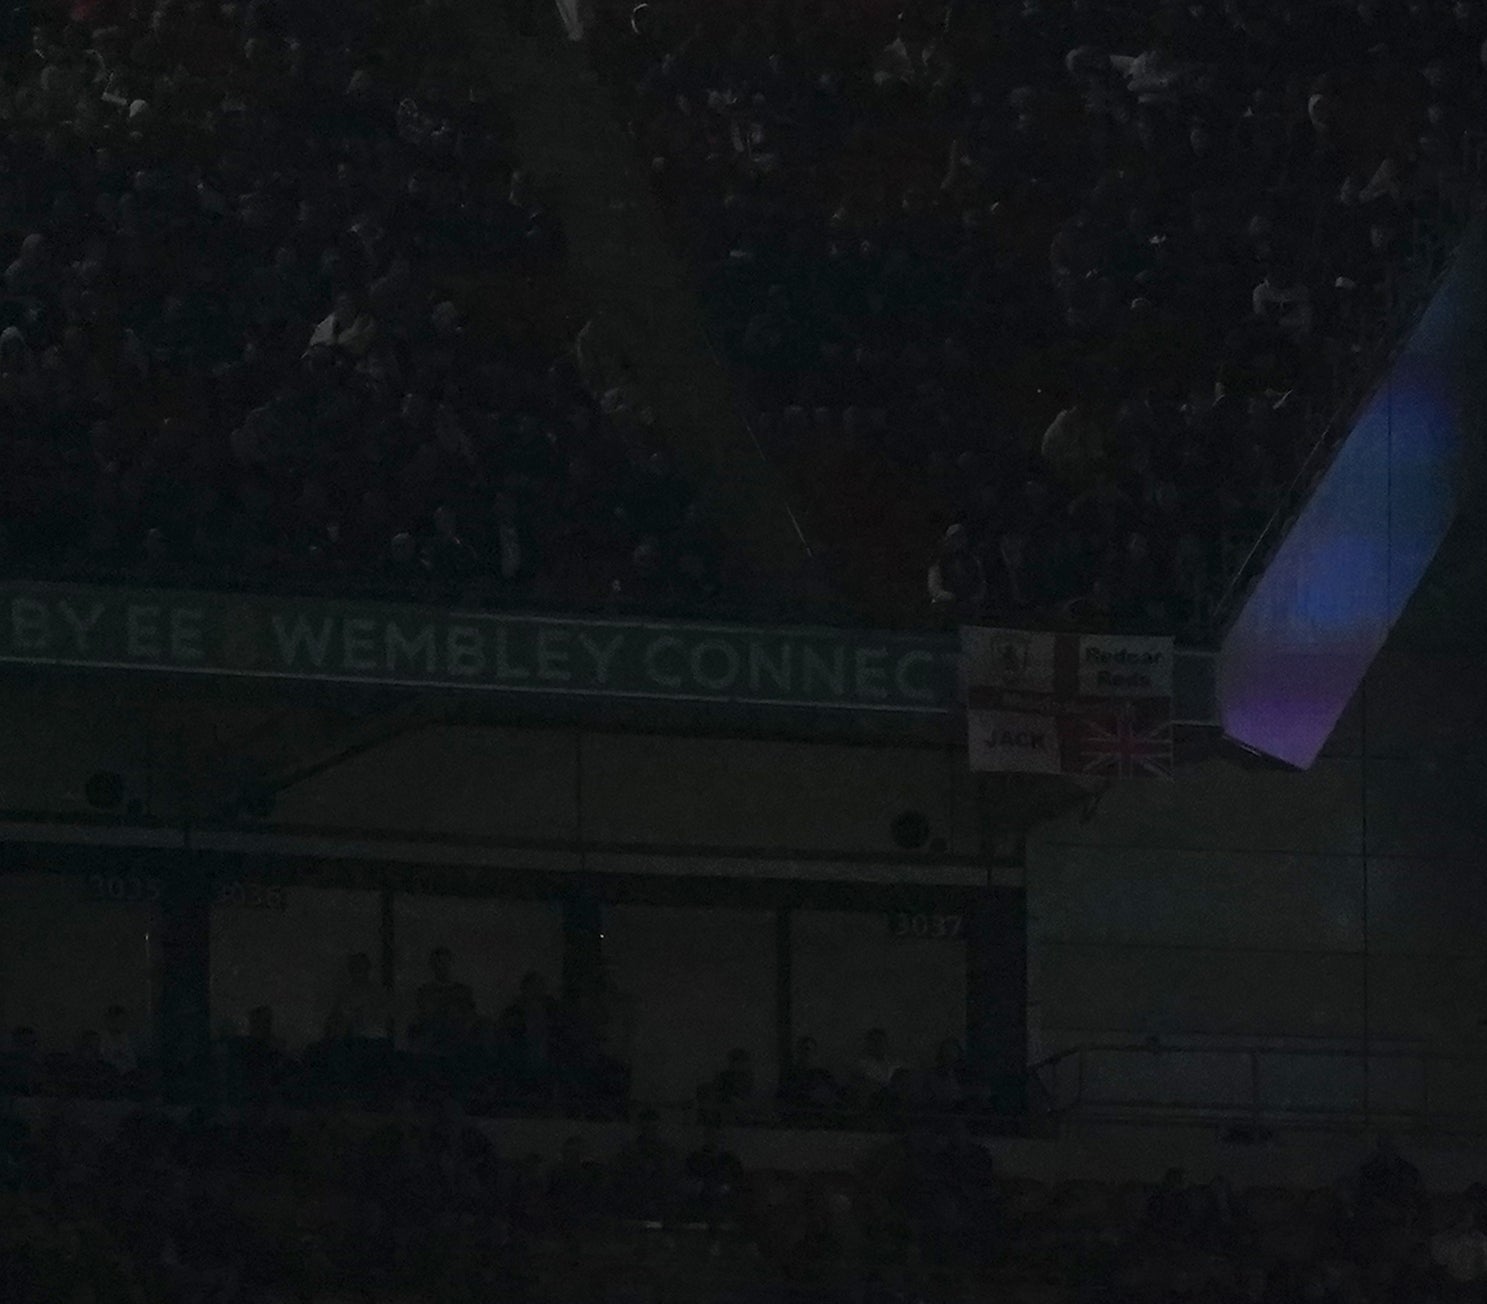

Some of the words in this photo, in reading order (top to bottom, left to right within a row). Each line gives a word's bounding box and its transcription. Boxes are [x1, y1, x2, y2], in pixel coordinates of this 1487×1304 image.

[10, 598, 105, 652] BY
[125, 604, 205, 661] EE
[271, 615, 625, 684] WEMBLEY
[645, 635, 940, 702] CONNEC
[984, 729, 1045, 750] JACK
